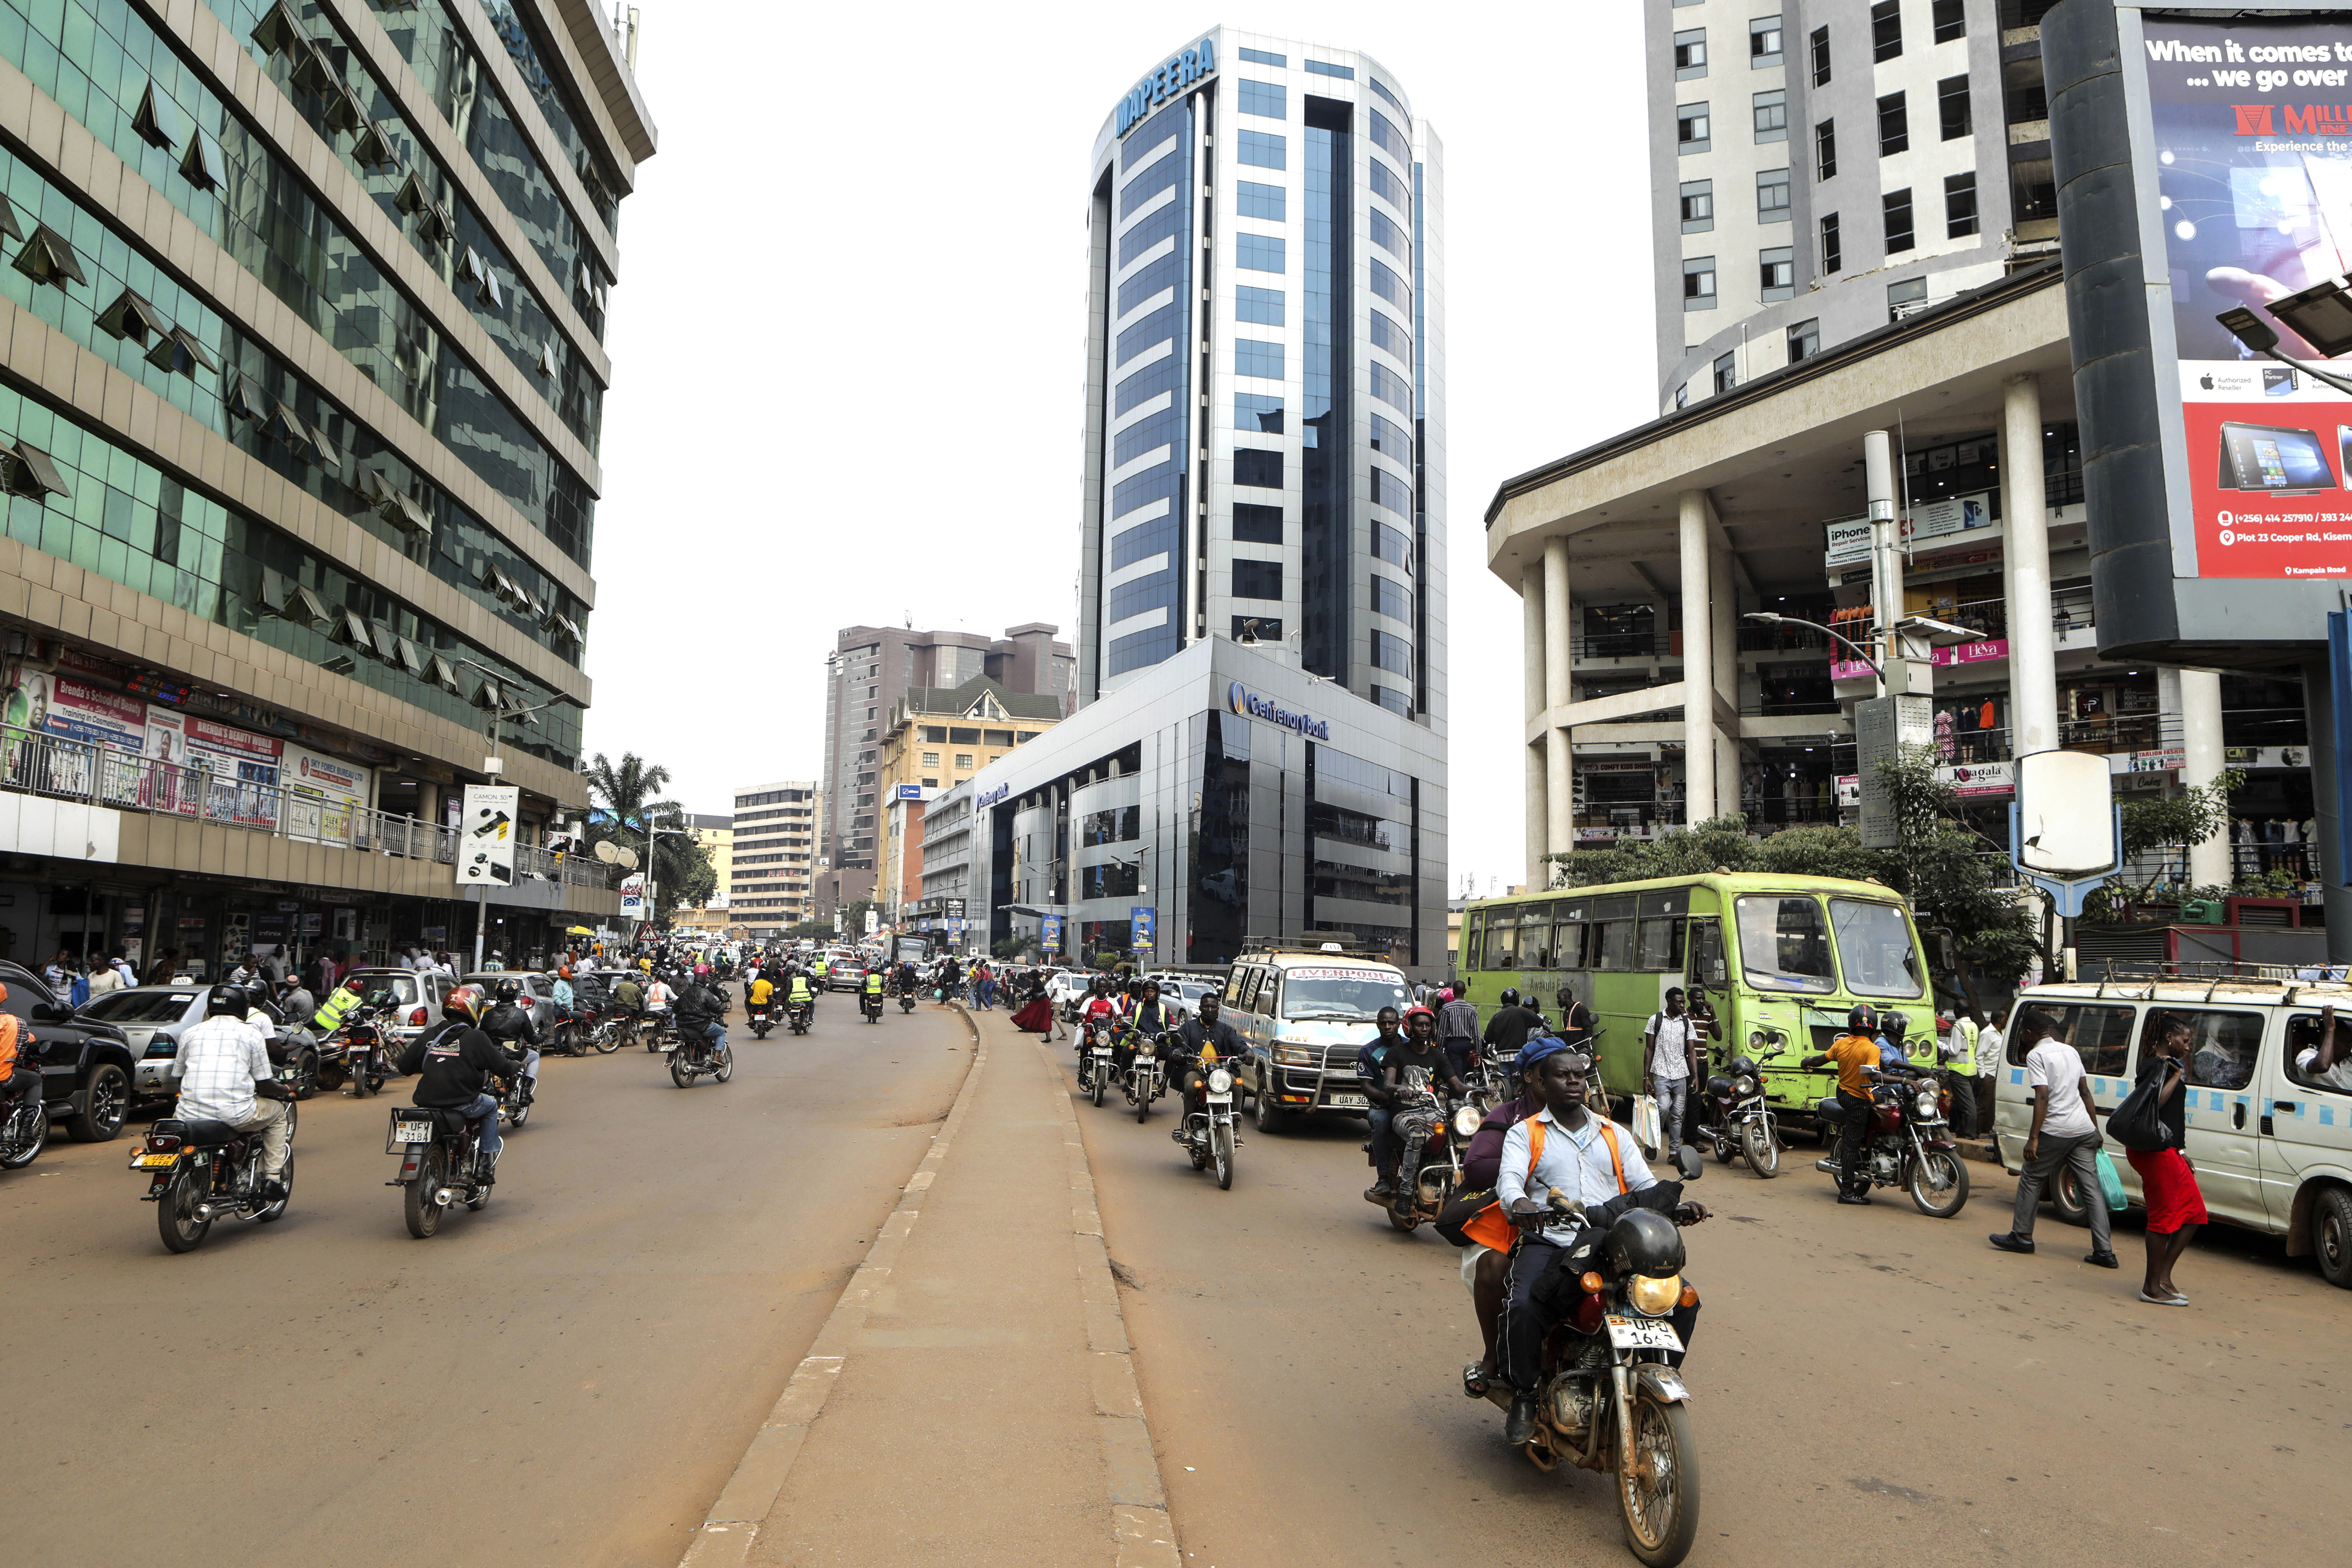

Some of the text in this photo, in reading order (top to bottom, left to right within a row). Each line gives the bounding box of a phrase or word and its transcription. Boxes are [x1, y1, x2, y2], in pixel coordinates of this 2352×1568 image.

[2145, 40, 2222, 62] When
[2225, 39, 2245, 63] it
[2249, 44, 2330, 62] comes
[2212, 69, 2250, 86] we
[2256, 69, 2288, 92] go
[2293, 68, 2347, 86] over
[1116, 38, 1214, 139] MAPEERA
[2320, 125, 2352, 134] INF
[2256, 141, 2348, 153] Experience the
[2235, 513, 2263, 524] (+256)
[2265, 514, 2280, 523] 414
[2282, 514, 2313, 522] 257910
[2315, 513, 2319, 523] /
[2321, 513, 2337, 522] 393
[1831, 526, 1870, 541] iPhone
[1849, 535, 1871, 544] Services
[2237, 532, 2352, 544] Plot 23 Cooper Rd, Kisem
[1969, 644, 1997, 657] Heya
[60, 680, 90, 700] Brenda's
[91, 689, 112, 706] School
[113, 697, 119, 708] of
[121, 698, 141, 717] Beauty
[95, 705, 107, 715] Skin
[108, 709, 123, 719] Clinic
[1248, 693, 1330, 741] Centenary Bank
[62, 707, 127, 732] Training in Cosmetology
[197, 721, 228, 740] BRENDA'S
[229, 730, 252, 744] BEAUTY
[252, 735, 272, 749] WORLD
[310, 758, 363, 781] SKY FOREX BUREAU LTD
[1953, 765, 2002, 783] Kwagala
[338, 777, 352, 786] Services
[2137, 776, 2163, 788] Cakes
[1292, 969, 1389, 980] LIVERPOOL
[1530, 978, 1555, 992] Awakula
[1357, 1096, 1369, 1105] 302
[405, 1132, 428, 1141] 318A
